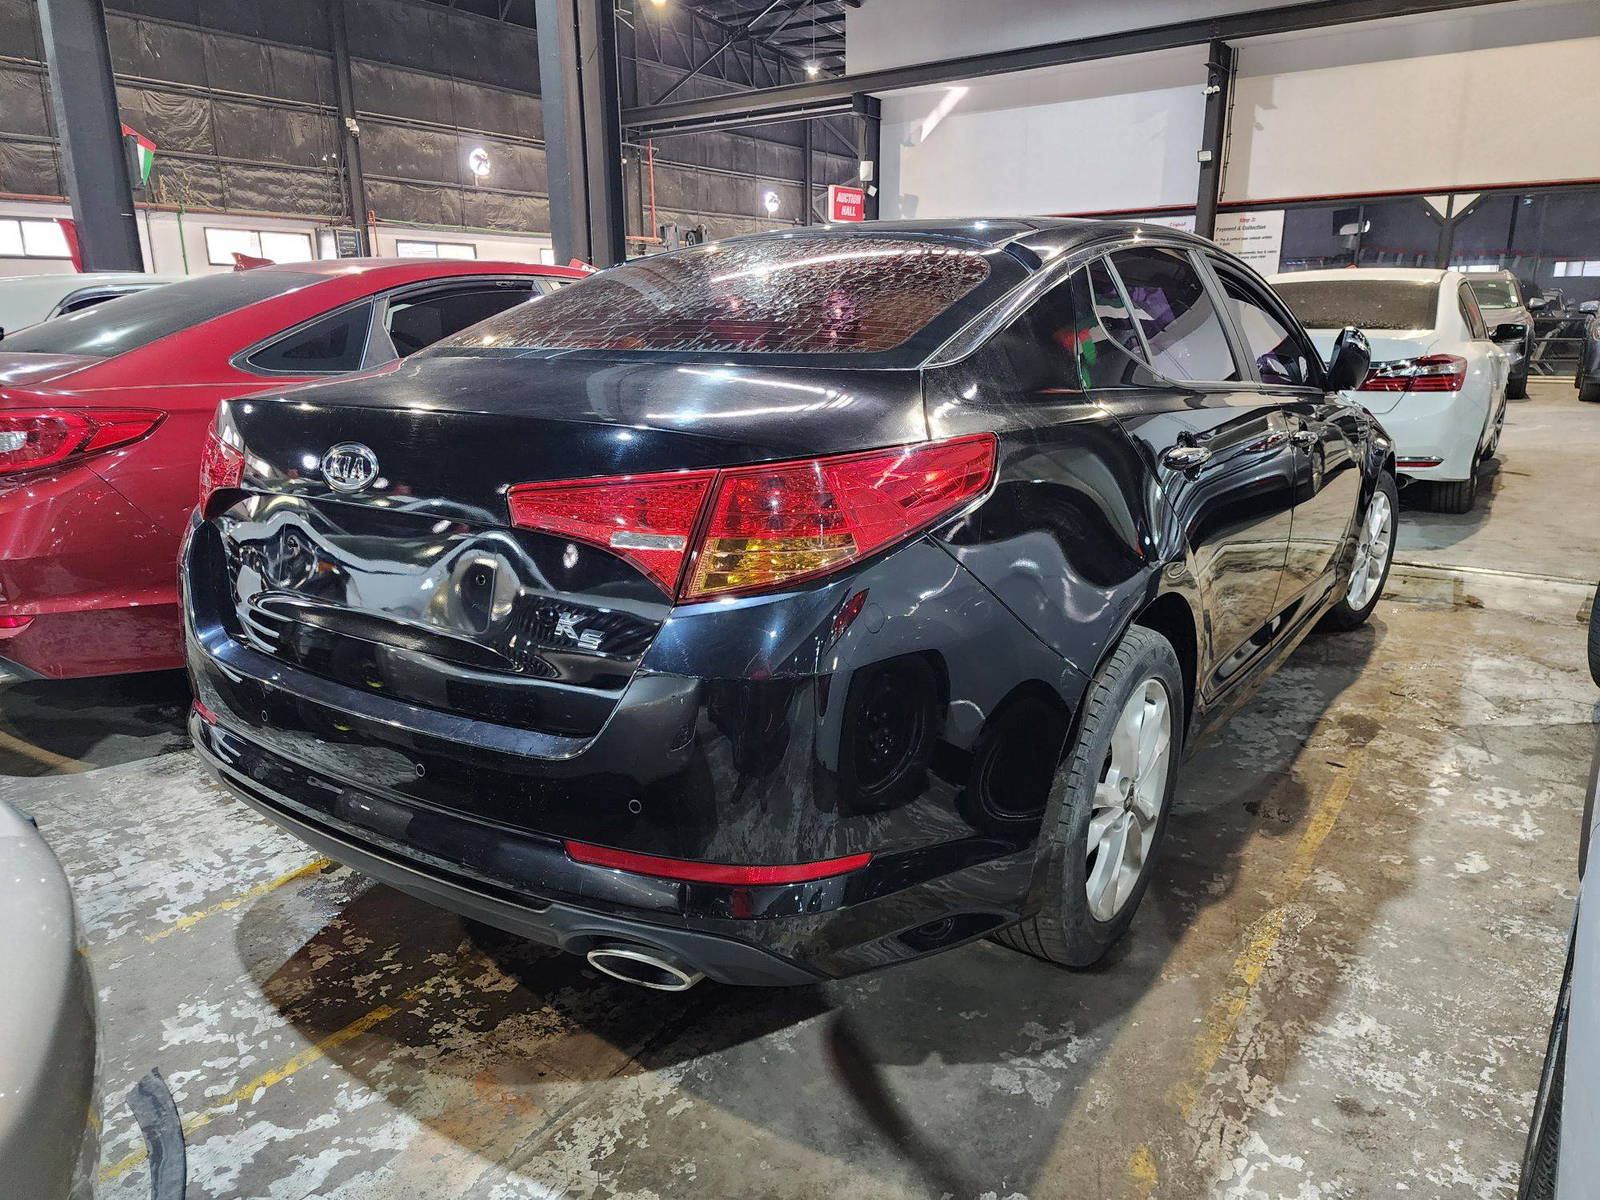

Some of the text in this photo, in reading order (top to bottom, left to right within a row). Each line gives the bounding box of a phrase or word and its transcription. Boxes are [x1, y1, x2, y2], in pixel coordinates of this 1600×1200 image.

[836, 192, 862, 204] AUCTION
[841, 205, 856, 216] HALL
[330, 455, 364, 480] KIA
